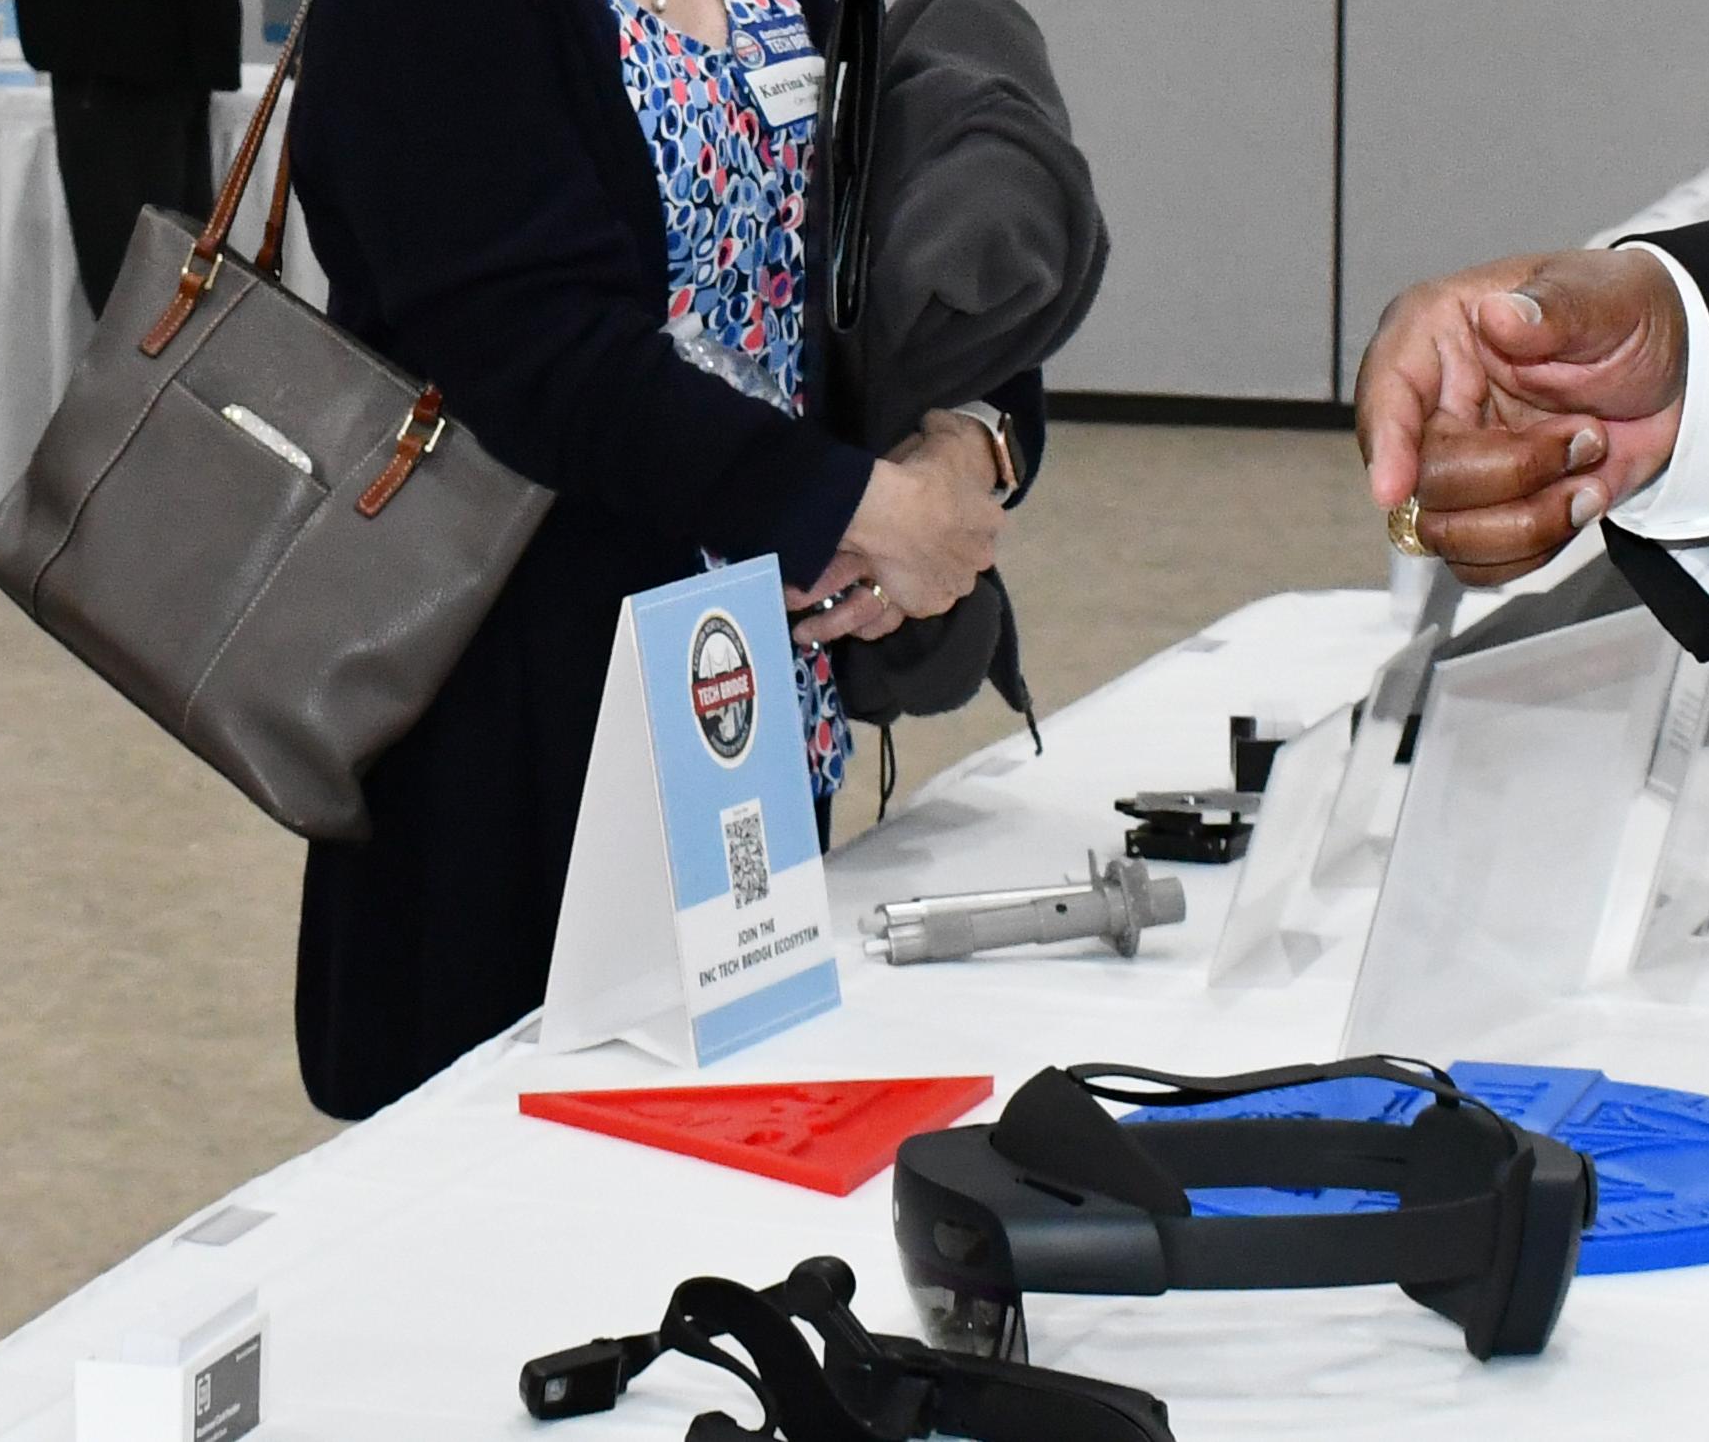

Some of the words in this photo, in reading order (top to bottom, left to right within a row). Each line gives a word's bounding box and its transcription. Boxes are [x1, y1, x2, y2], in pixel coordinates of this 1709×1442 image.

[759, 79, 805, 99] Katrina
[698, 683, 721, 707] TECH
[720, 674, 749, 700] BRIDGE
[738, 926, 758, 947] JOIN
[760, 918, 775, 936] THE
[699, 967, 717, 987] ENC
[718, 958, 740, 978] TECH
[742, 944, 773, 969] BRIDGE
[774, 926, 819, 956] ECOSYSTEM
